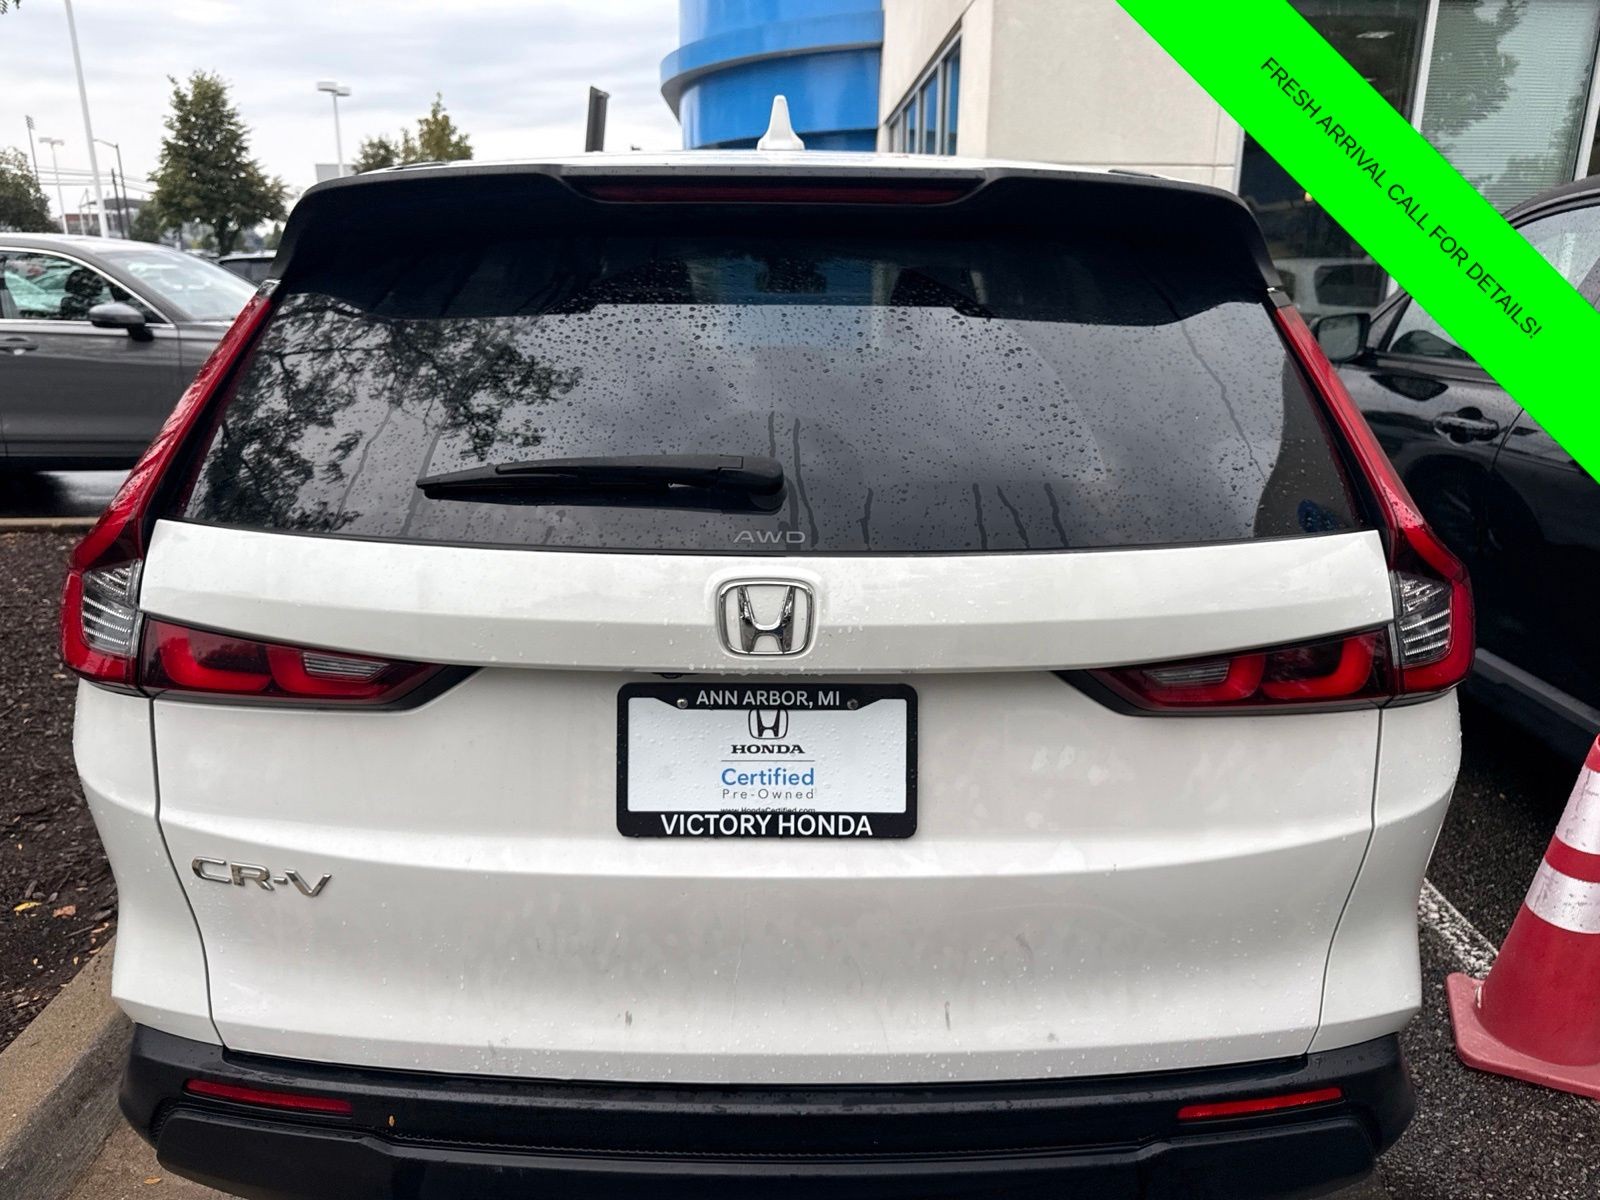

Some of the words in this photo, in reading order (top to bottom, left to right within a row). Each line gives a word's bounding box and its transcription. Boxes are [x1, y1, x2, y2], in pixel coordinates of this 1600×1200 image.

[733, 530, 806, 544] AWD
[696, 690, 738, 705] ANN
[742, 690, 813, 708] ARBOR,
[818, 691, 840, 706] MI
[731, 744, 805, 754] HONDA
[721, 767, 815, 786] Certified
[722, 788, 814, 800] Pre-Owned
[660, 814, 771, 836] VICTORY
[778, 815, 873, 837] HONDA
[191, 856, 332, 898] CR-V
